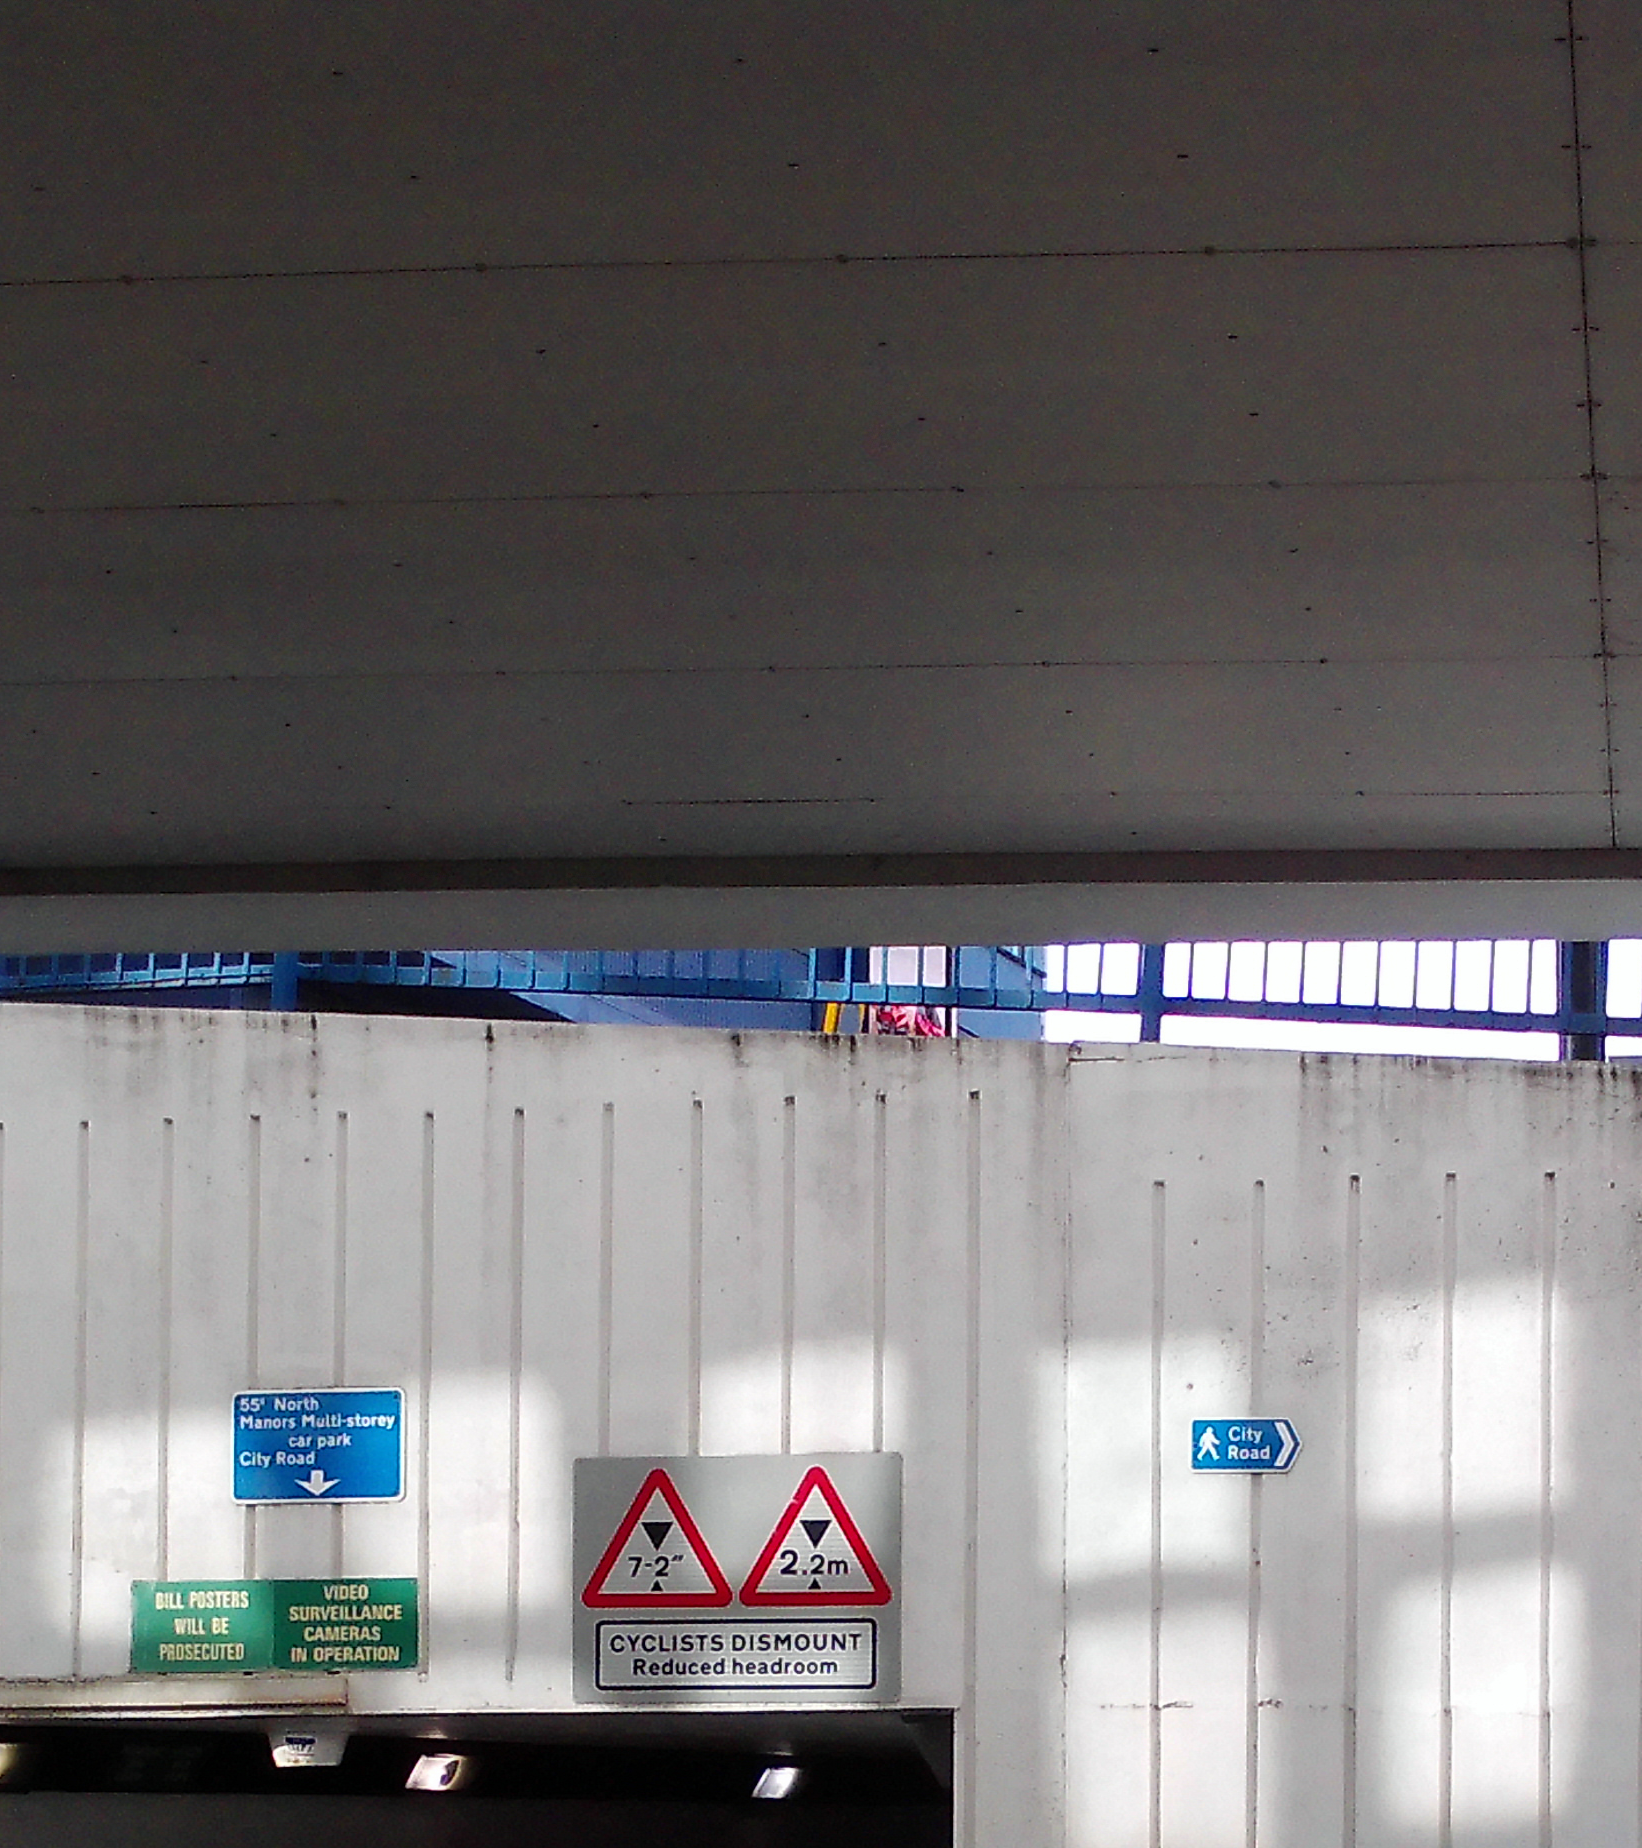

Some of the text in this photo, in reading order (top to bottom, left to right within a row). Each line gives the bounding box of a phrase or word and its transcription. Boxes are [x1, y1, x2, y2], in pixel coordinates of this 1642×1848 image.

[274, 1397, 320, 1411] North
[240, 1412, 395, 1429] Manors Multi-storey
[288, 1433, 352, 1449] car park
[1228, 1426, 1262, 1443] City
[239, 1451, 315, 1468] City Road
[1227, 1445, 1271, 1460] Road
[779, 1550, 849, 1576] 2.2m
[155, 1591, 249, 1609] BILL POSTERS
[324, 1584, 369, 1600] VIDEO
[289, 1604, 403, 1621] SURVEILLANCE
[174, 1617, 229, 1635] WILL BE
[304, 1626, 381, 1641] CAMERAS
[610, 1633, 861, 1652] CYCLISTS DISMOUNT
[159, 1643, 244, 1660] PROSECUTED
[291, 1646, 399, 1662] IN OPERATION
[633, 1658, 837, 1676] Reduced headroom
